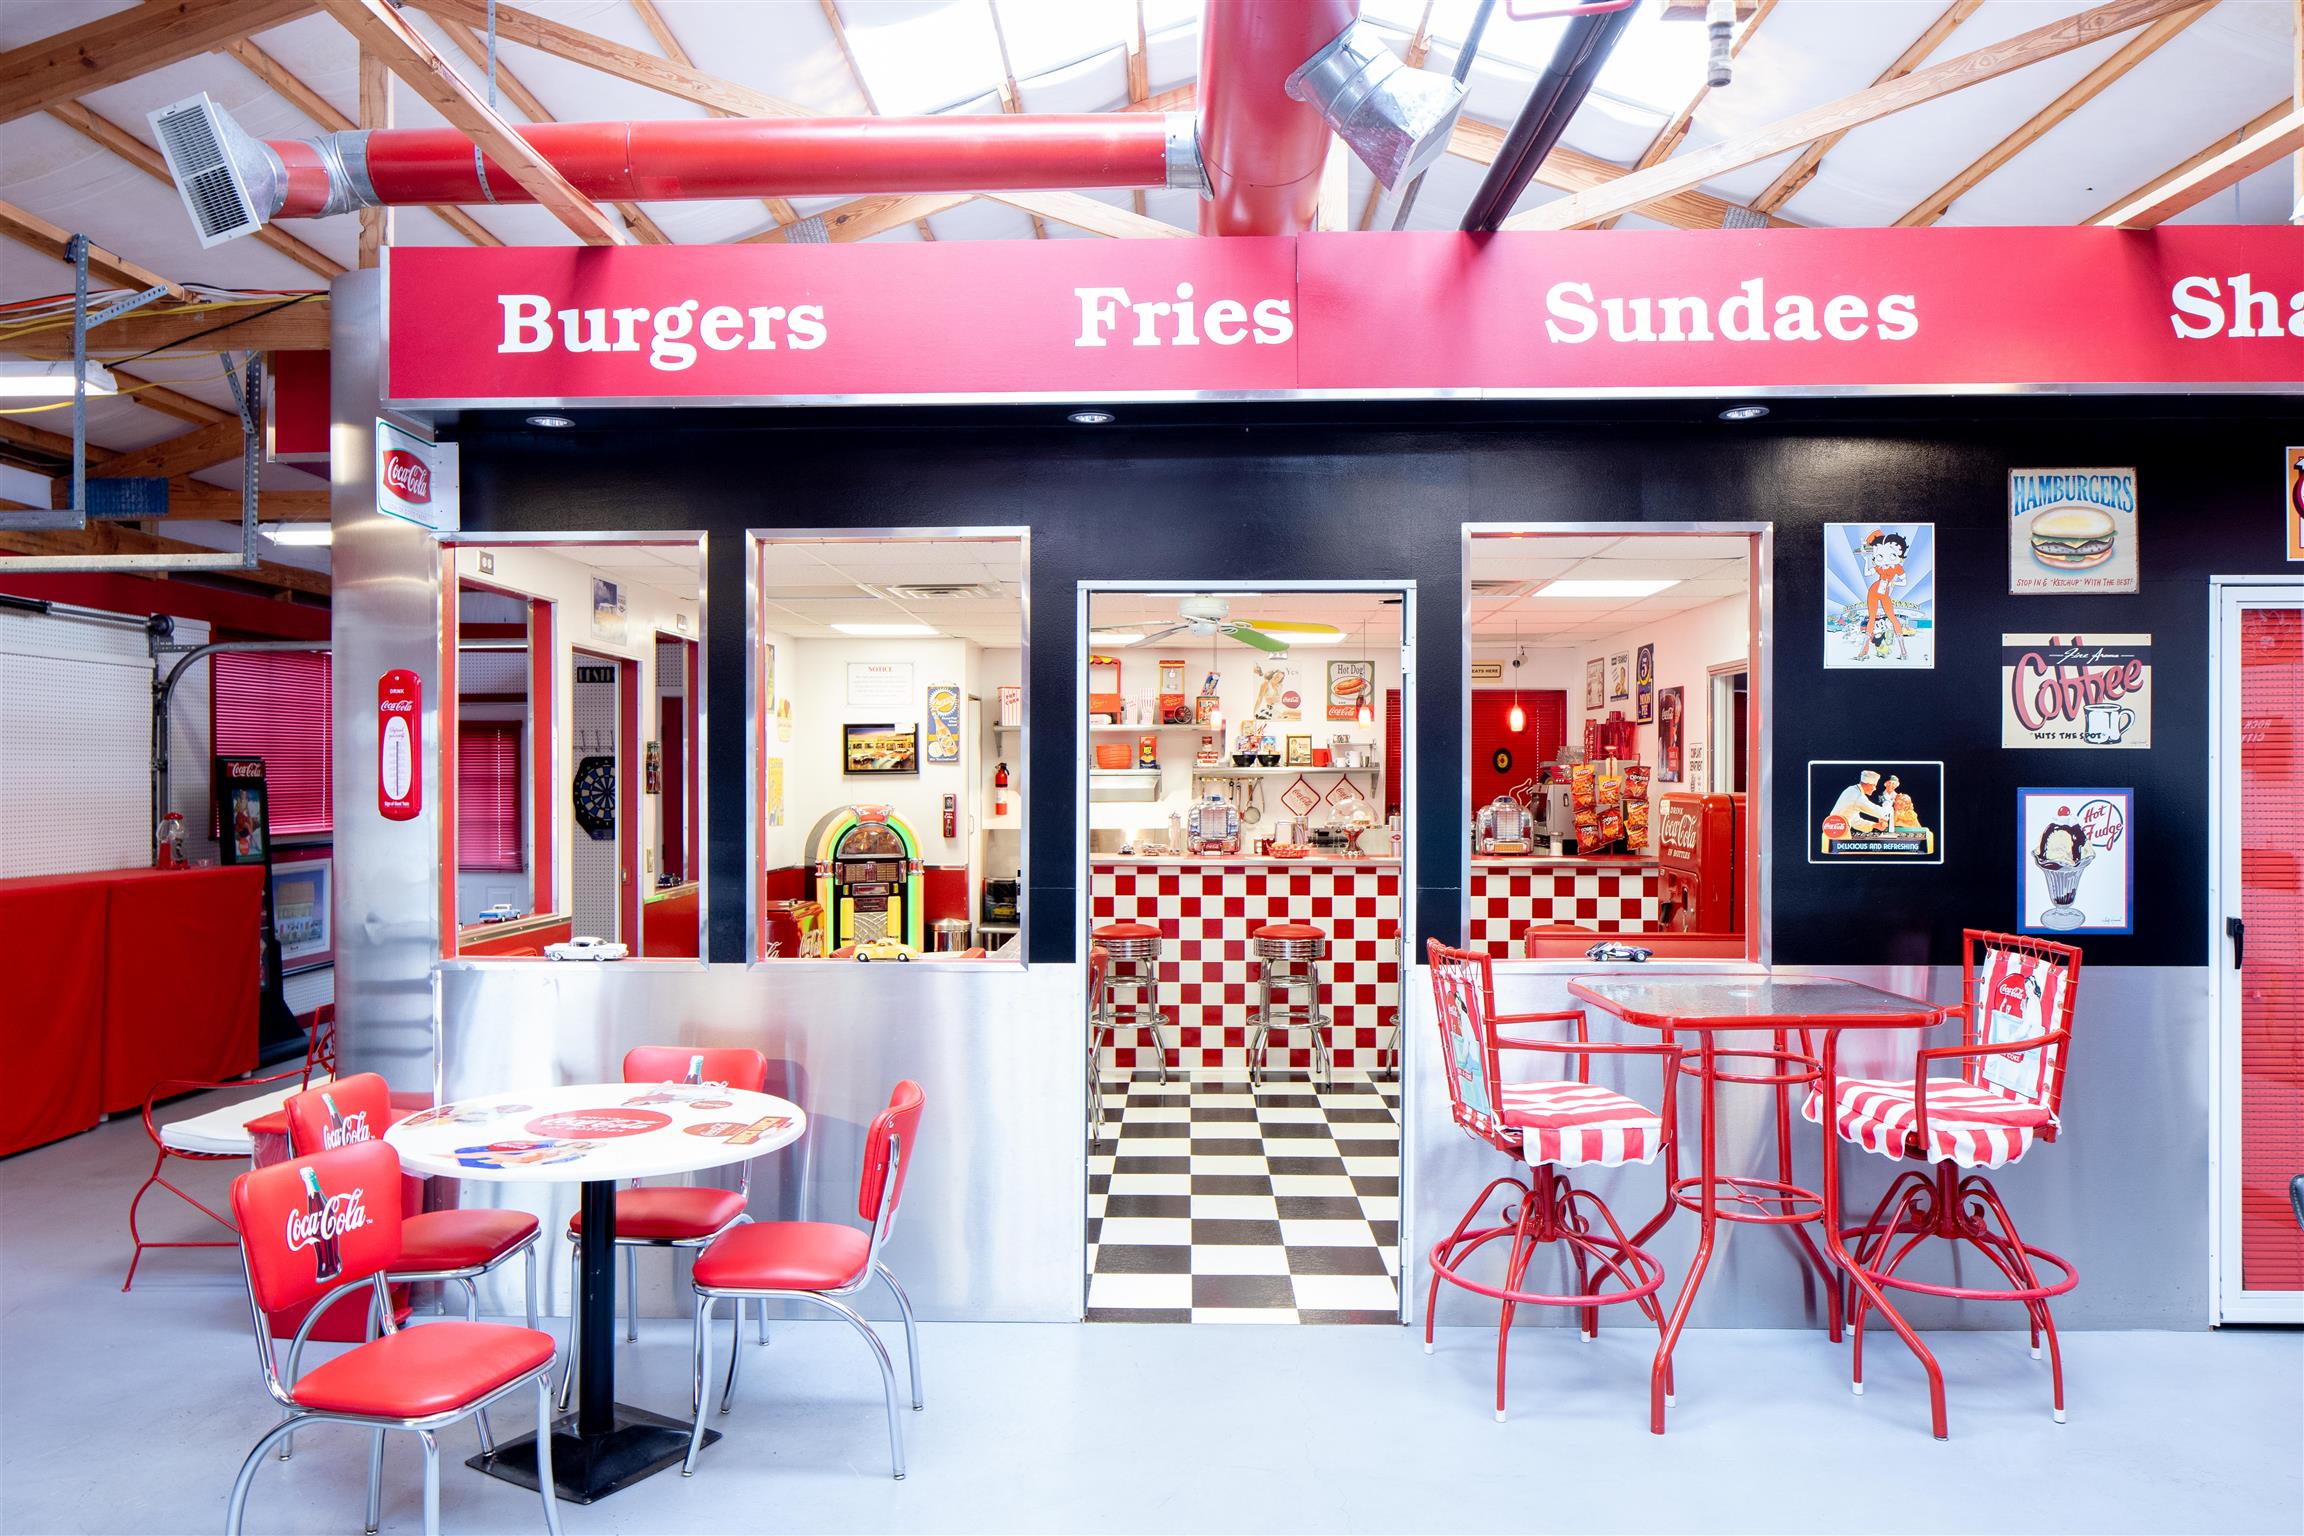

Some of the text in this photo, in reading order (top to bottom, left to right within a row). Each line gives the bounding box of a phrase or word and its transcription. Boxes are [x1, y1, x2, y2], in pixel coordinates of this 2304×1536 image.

[1074, 282, 1294, 347] Fries
[1544, 277, 1919, 343] Sundaes
[497, 295, 827, 371] Burgers
[387, 456, 427, 497] Coca-Cola
[2013, 475, 2135, 516] HAMBURGERS
[2017, 578, 2032, 586] STOP
[2034, 578, 2041, 586] IN
[2084, 578, 2101, 586] WITH
[2103, 578, 2116, 586] THE
[2056, 647, 2089, 664] Fine
[1337, 664, 1349, 675] Hot
[2012, 635, 2144, 731] Coffee
[381, 700, 414, 712] Coca-Cola
[1328, 706, 1356, 717] Coca-Cola
[2059, 732, 2078, 740] THE
[232, 762, 261, 777] Coca-Cola
[2084, 805, 2108, 823] Hot
[1661, 815, 1698, 849] Coca-Cola
[2082, 804, 2122, 851] Fudge
[1673, 850, 1690, 860] BOTTLES
[1836, 842, 1919, 850] DELICIOUS AND REFRESHING
[2000, 984, 2024, 1000] Coca-Cola
[324, 1111, 370, 1150] Coca-Cola
[286, 1188, 366, 1252] Coca-Cola
